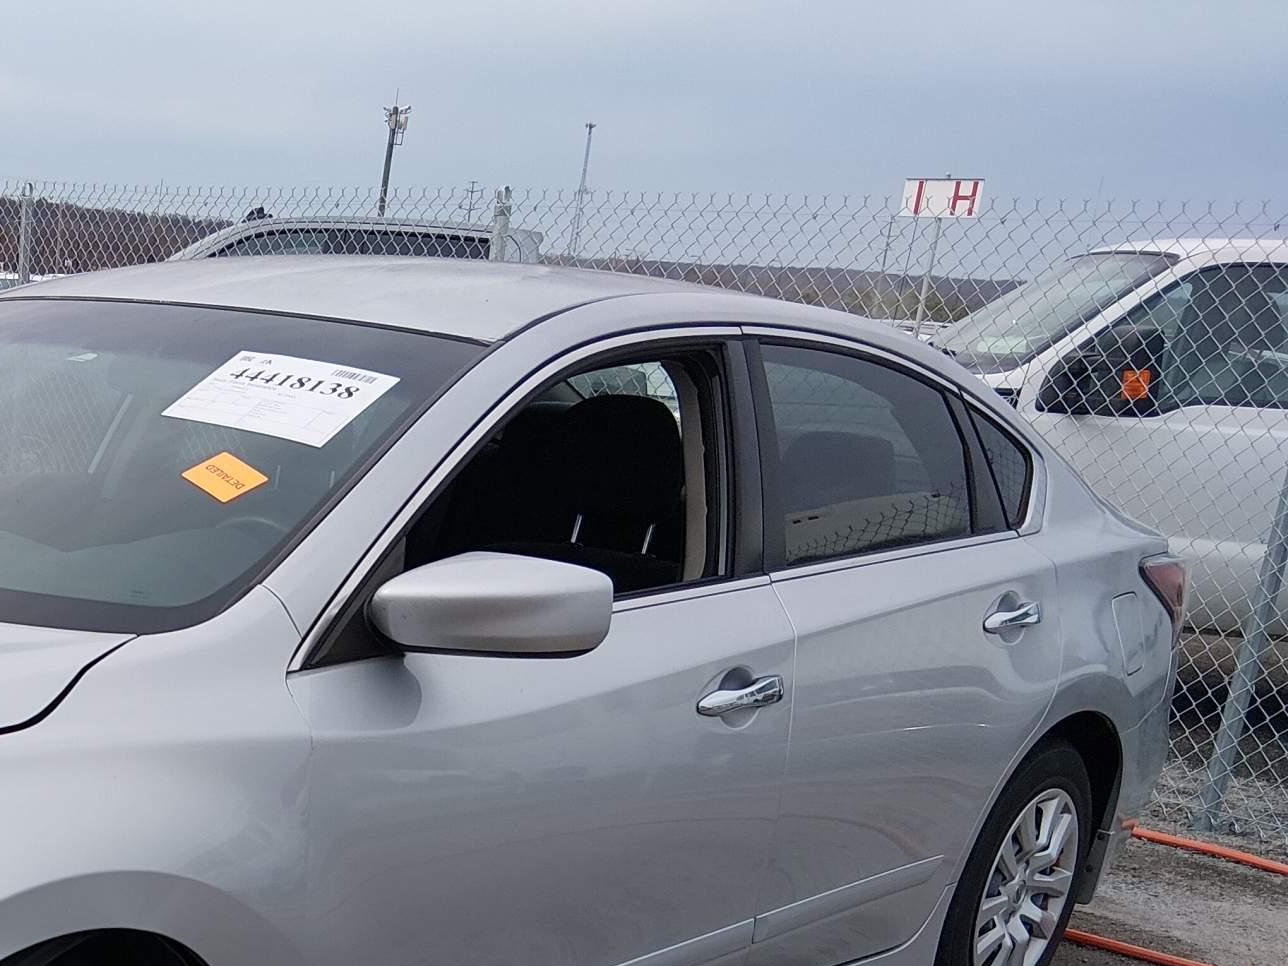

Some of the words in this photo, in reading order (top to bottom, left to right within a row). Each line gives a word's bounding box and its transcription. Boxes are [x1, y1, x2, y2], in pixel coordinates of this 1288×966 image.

[949, 180, 979, 217] H
[230, 367, 360, 399] 44418138
[205, 464, 245, 490] DETAILED
